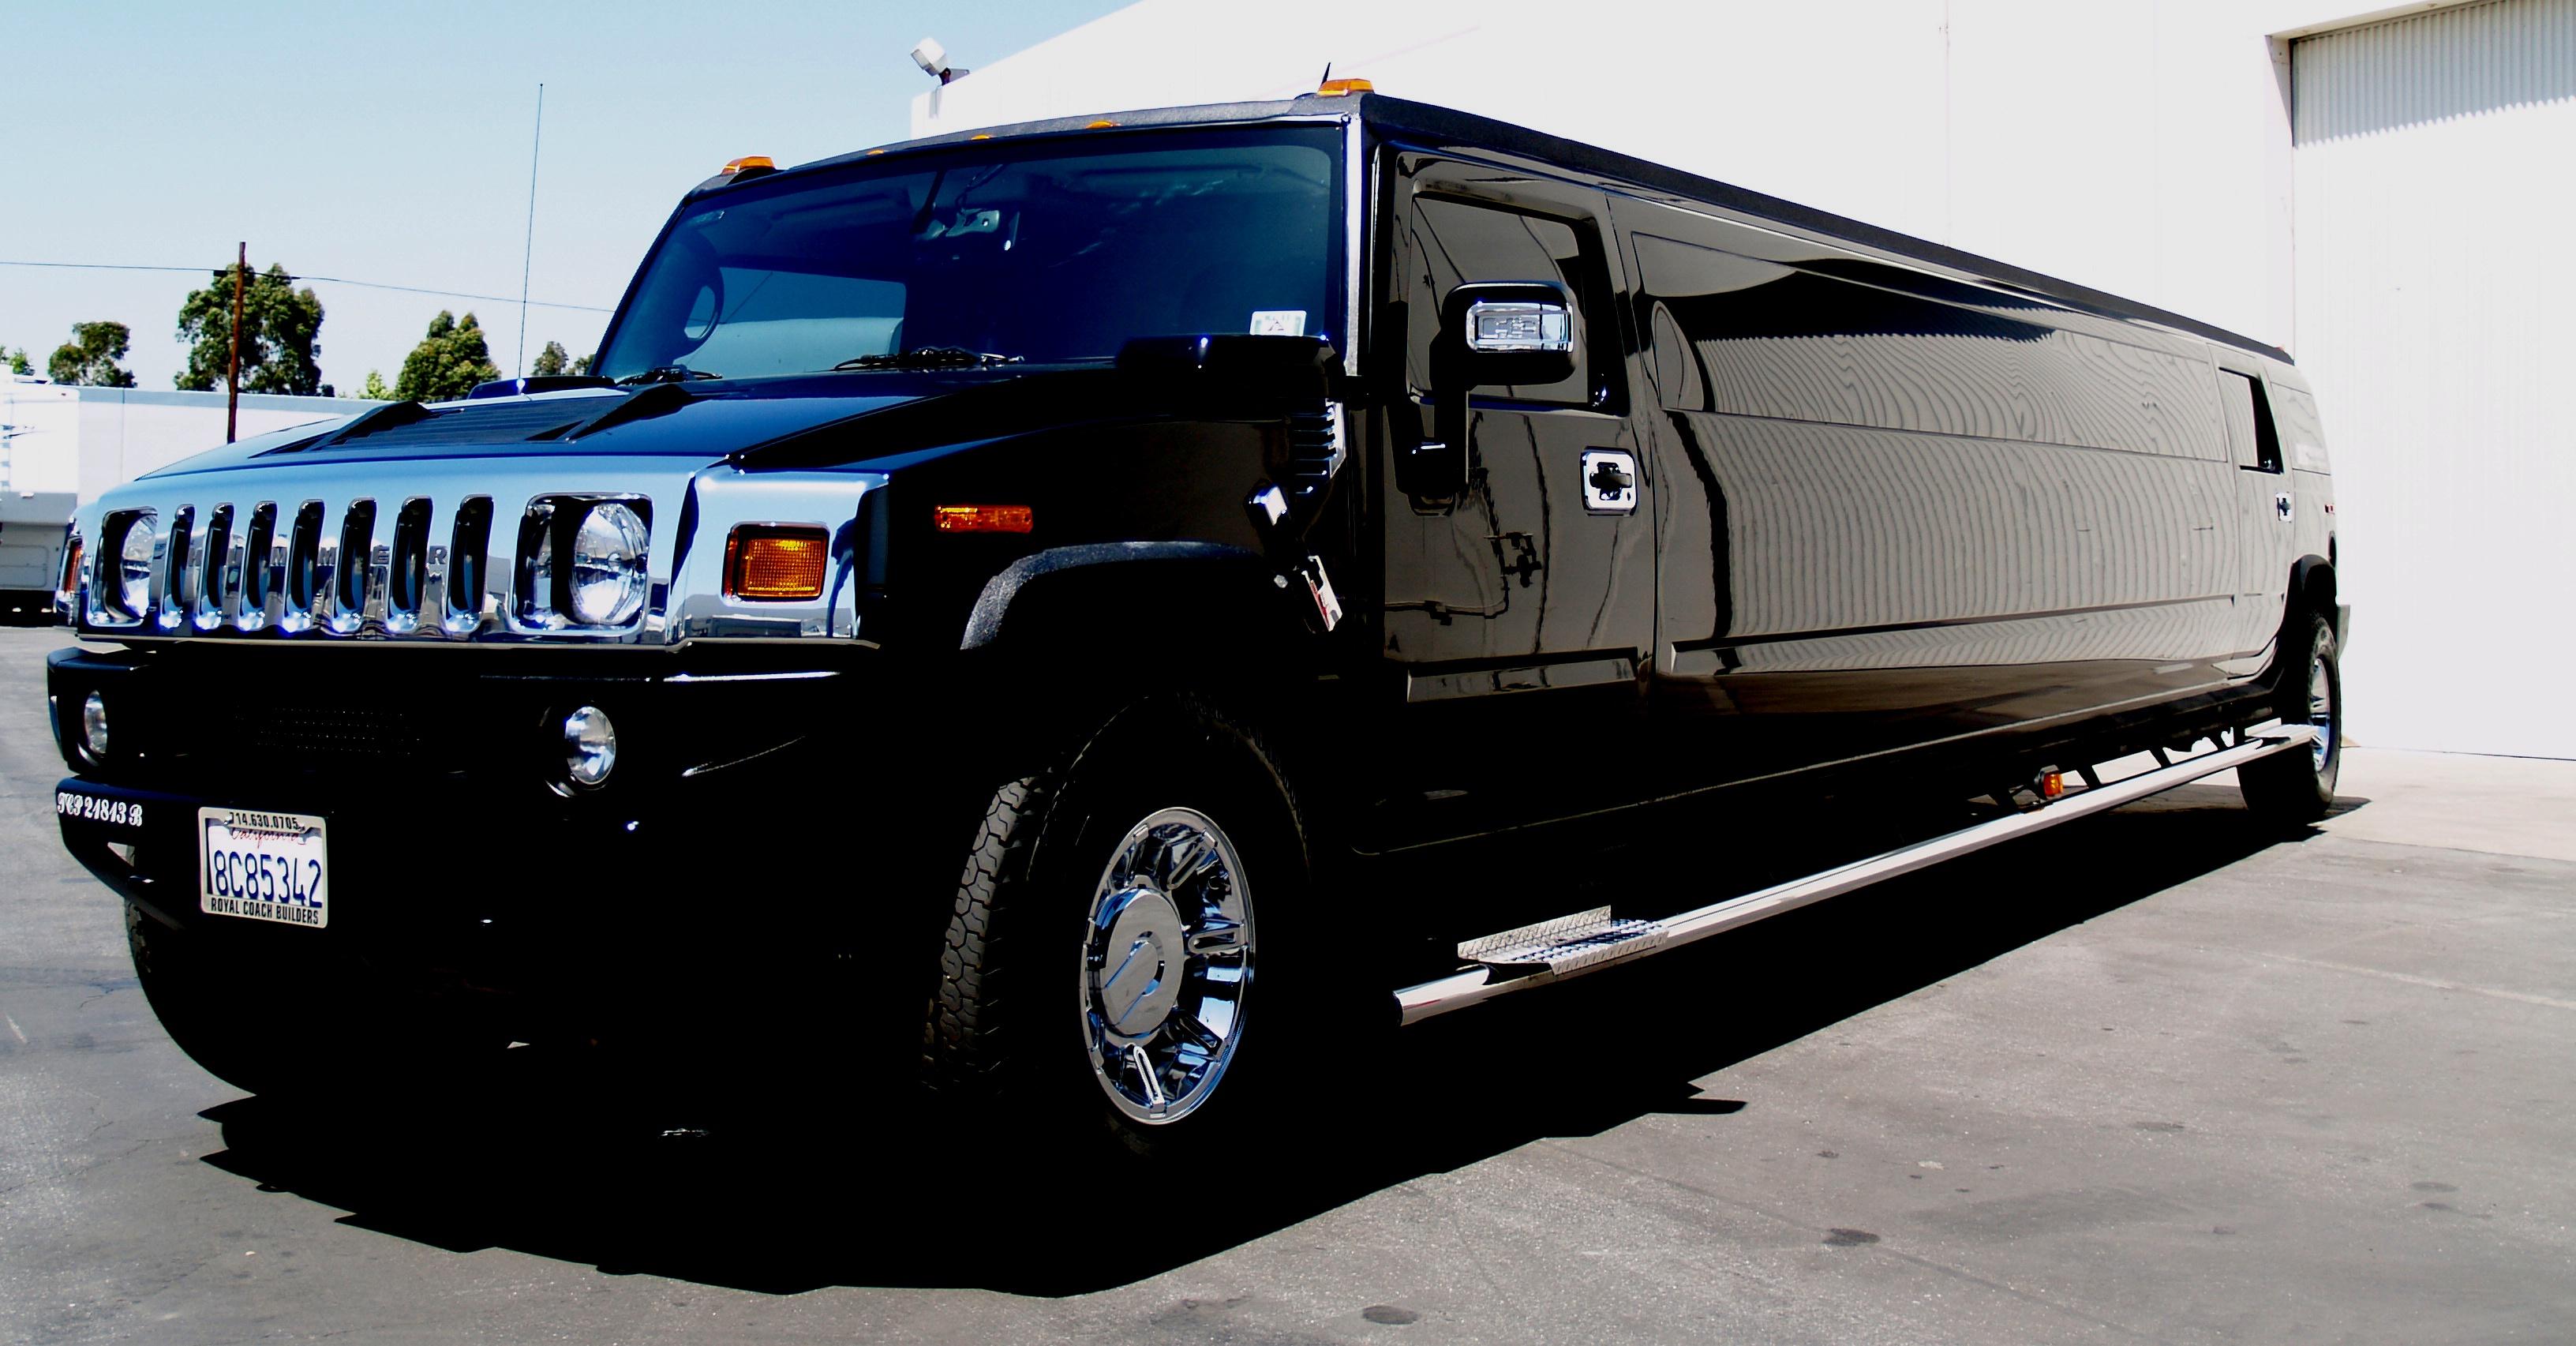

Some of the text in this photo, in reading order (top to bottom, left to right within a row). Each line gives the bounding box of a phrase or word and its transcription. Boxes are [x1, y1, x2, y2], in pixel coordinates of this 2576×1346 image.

[84, 797, 126, 824] 21813
[129, 804, 143, 827] B
[213, 849, 322, 909] 8C85342
[211, 898, 319, 924] ROYAL COACH BUILDERS
